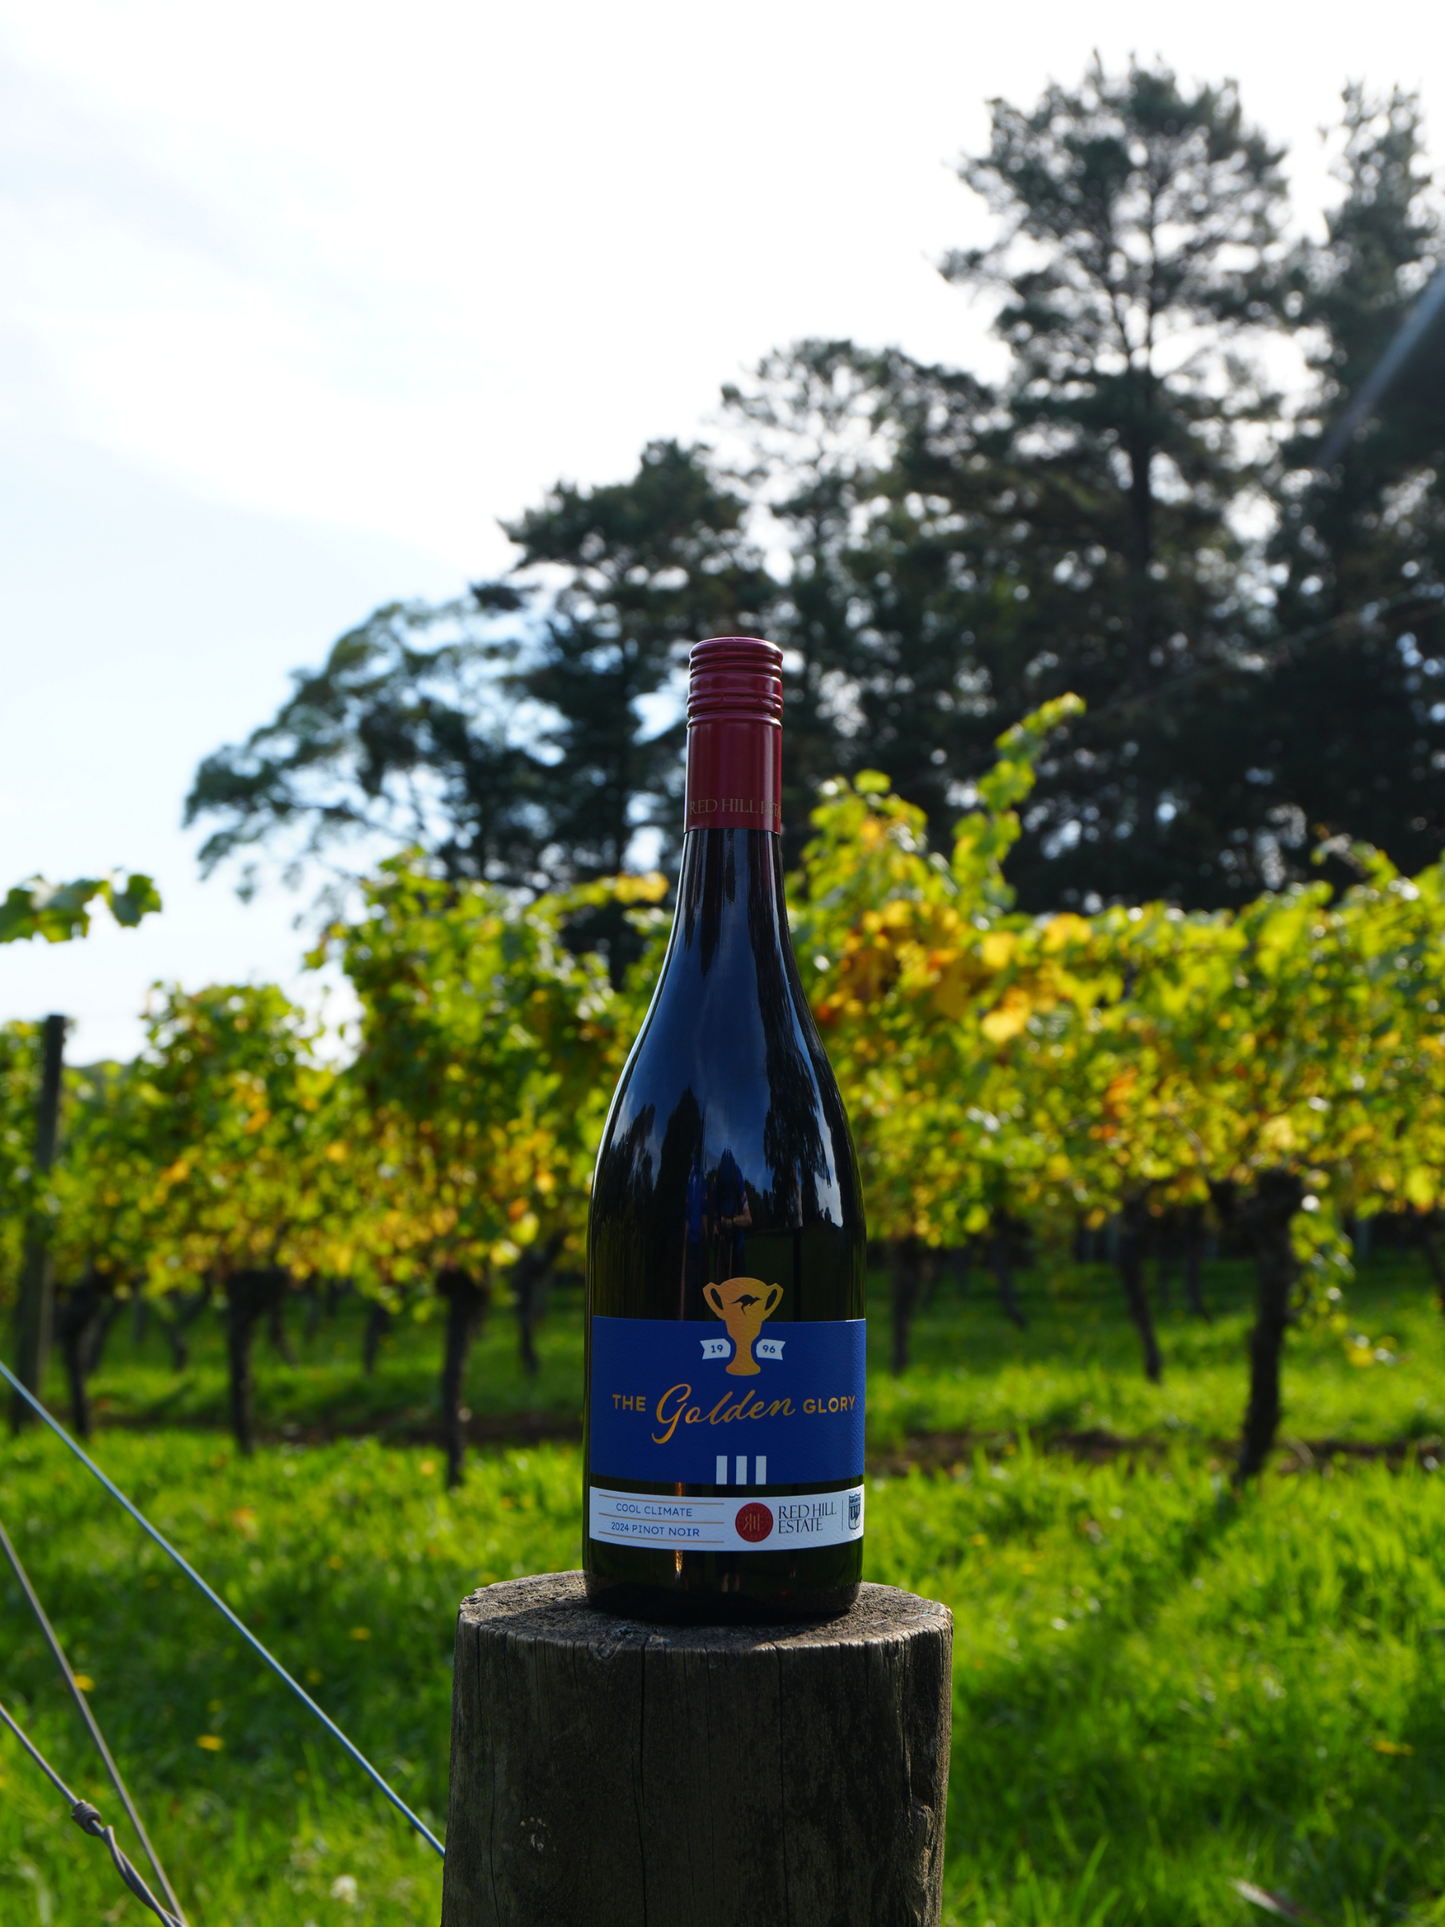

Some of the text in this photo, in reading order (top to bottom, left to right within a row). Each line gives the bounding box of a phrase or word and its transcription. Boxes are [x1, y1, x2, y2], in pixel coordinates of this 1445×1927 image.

[689, 799, 718, 815] RED
[721, 798, 758, 813] HILL
[710, 1344, 776, 1354] 19 96
[612, 1383, 856, 1444] THE Golden GLORY
[615, 1502, 693, 1517] COOL CLIMATE
[778, 1501, 837, 1520] RED HILL
[611, 1521, 700, 1537] 2024 PINOT NOIR
[778, 1516, 824, 1534] ESTATE
